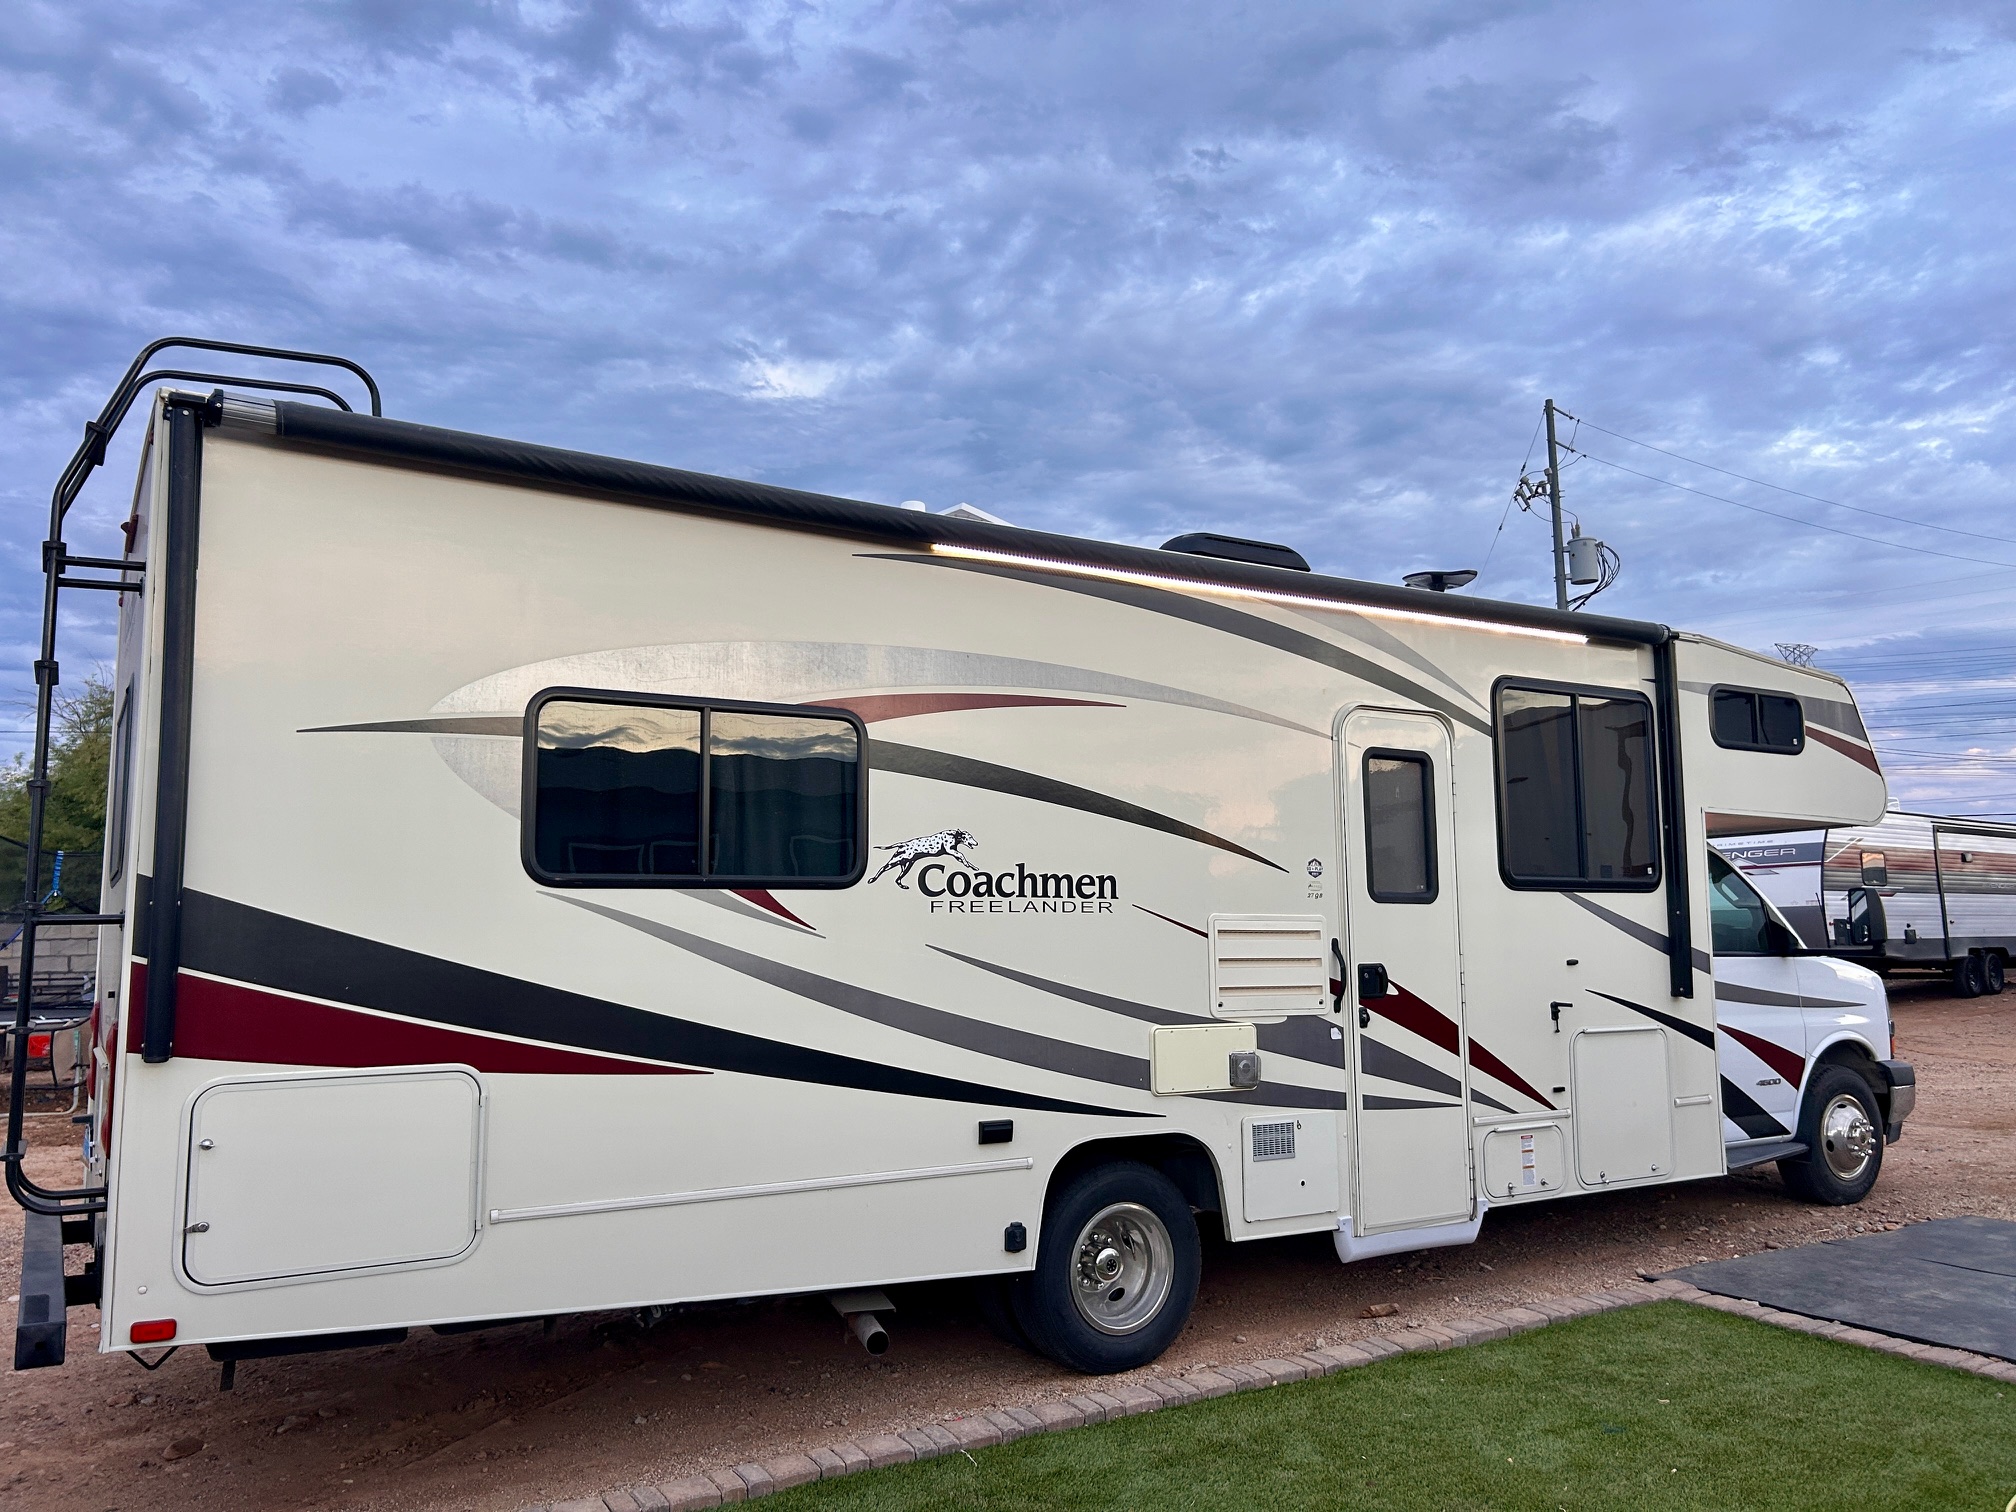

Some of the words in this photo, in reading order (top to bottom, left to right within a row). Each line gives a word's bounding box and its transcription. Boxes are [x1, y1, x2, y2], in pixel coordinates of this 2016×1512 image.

[1713, 839, 1774, 847] RIMETIME
[917, 862, 1119, 900] Coachmen
[930, 900, 1114, 914] FREELANDER
